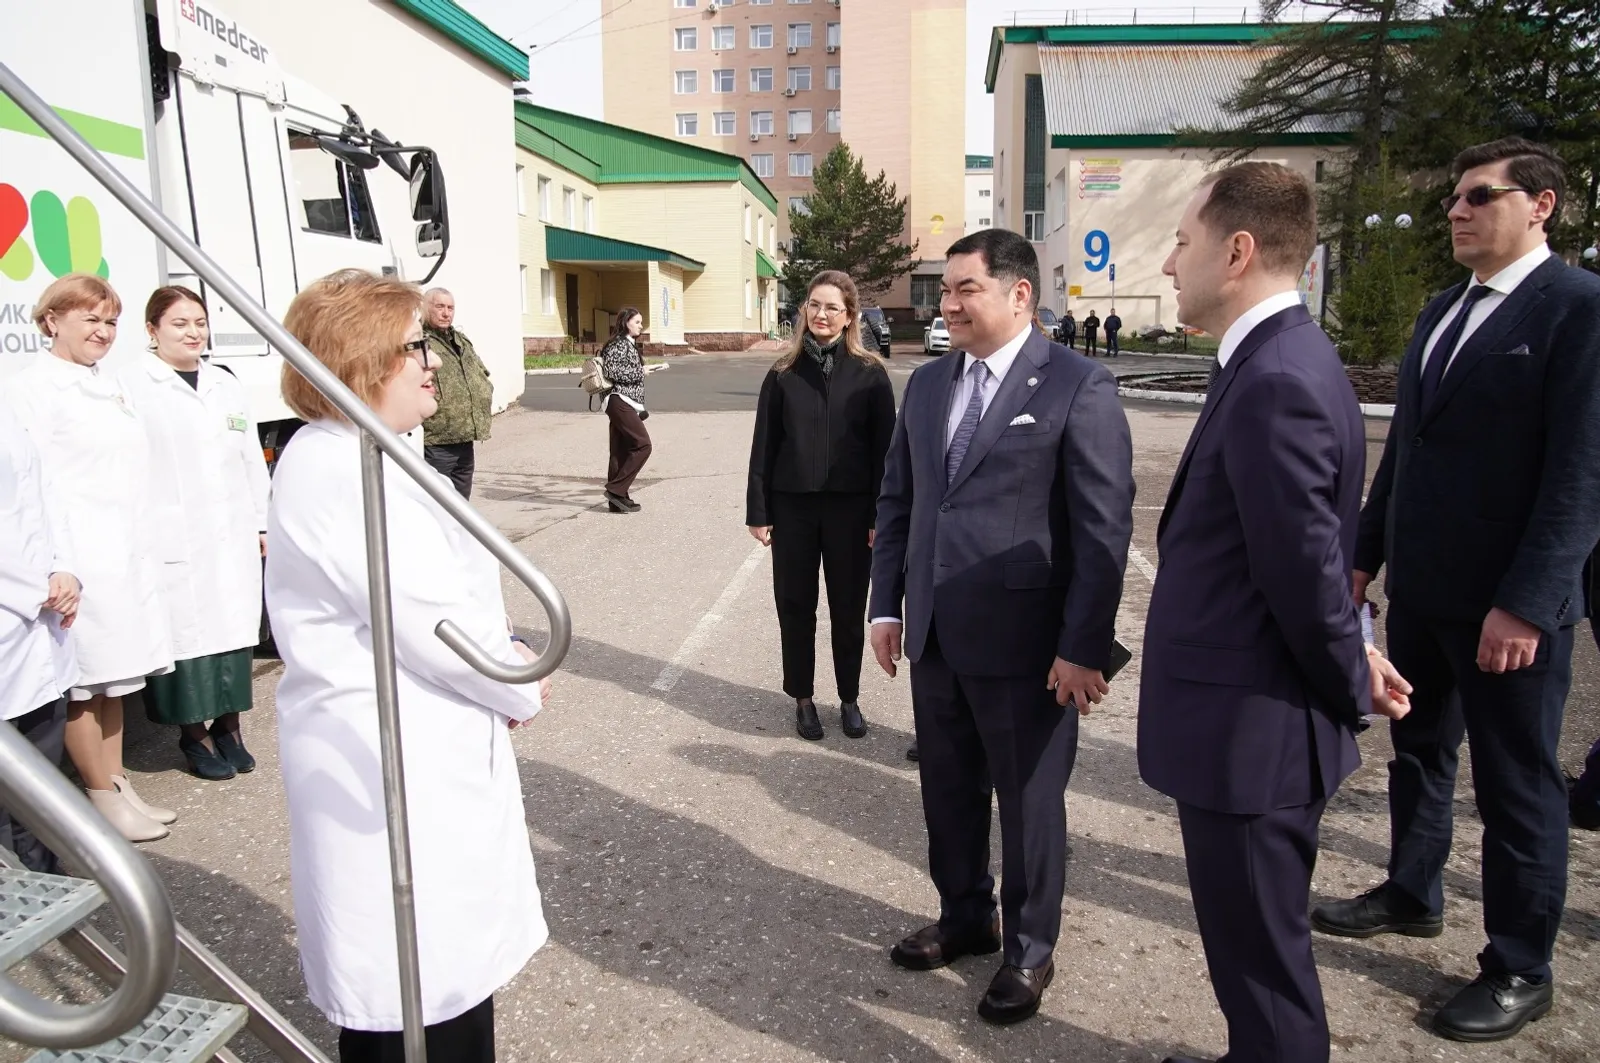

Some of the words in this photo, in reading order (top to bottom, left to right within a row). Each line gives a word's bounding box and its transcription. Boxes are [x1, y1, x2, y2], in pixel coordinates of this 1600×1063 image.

[196, 6, 268, 64] medcar
[930, 215, 944, 234] 2
[1084, 230, 1110, 272] 9
